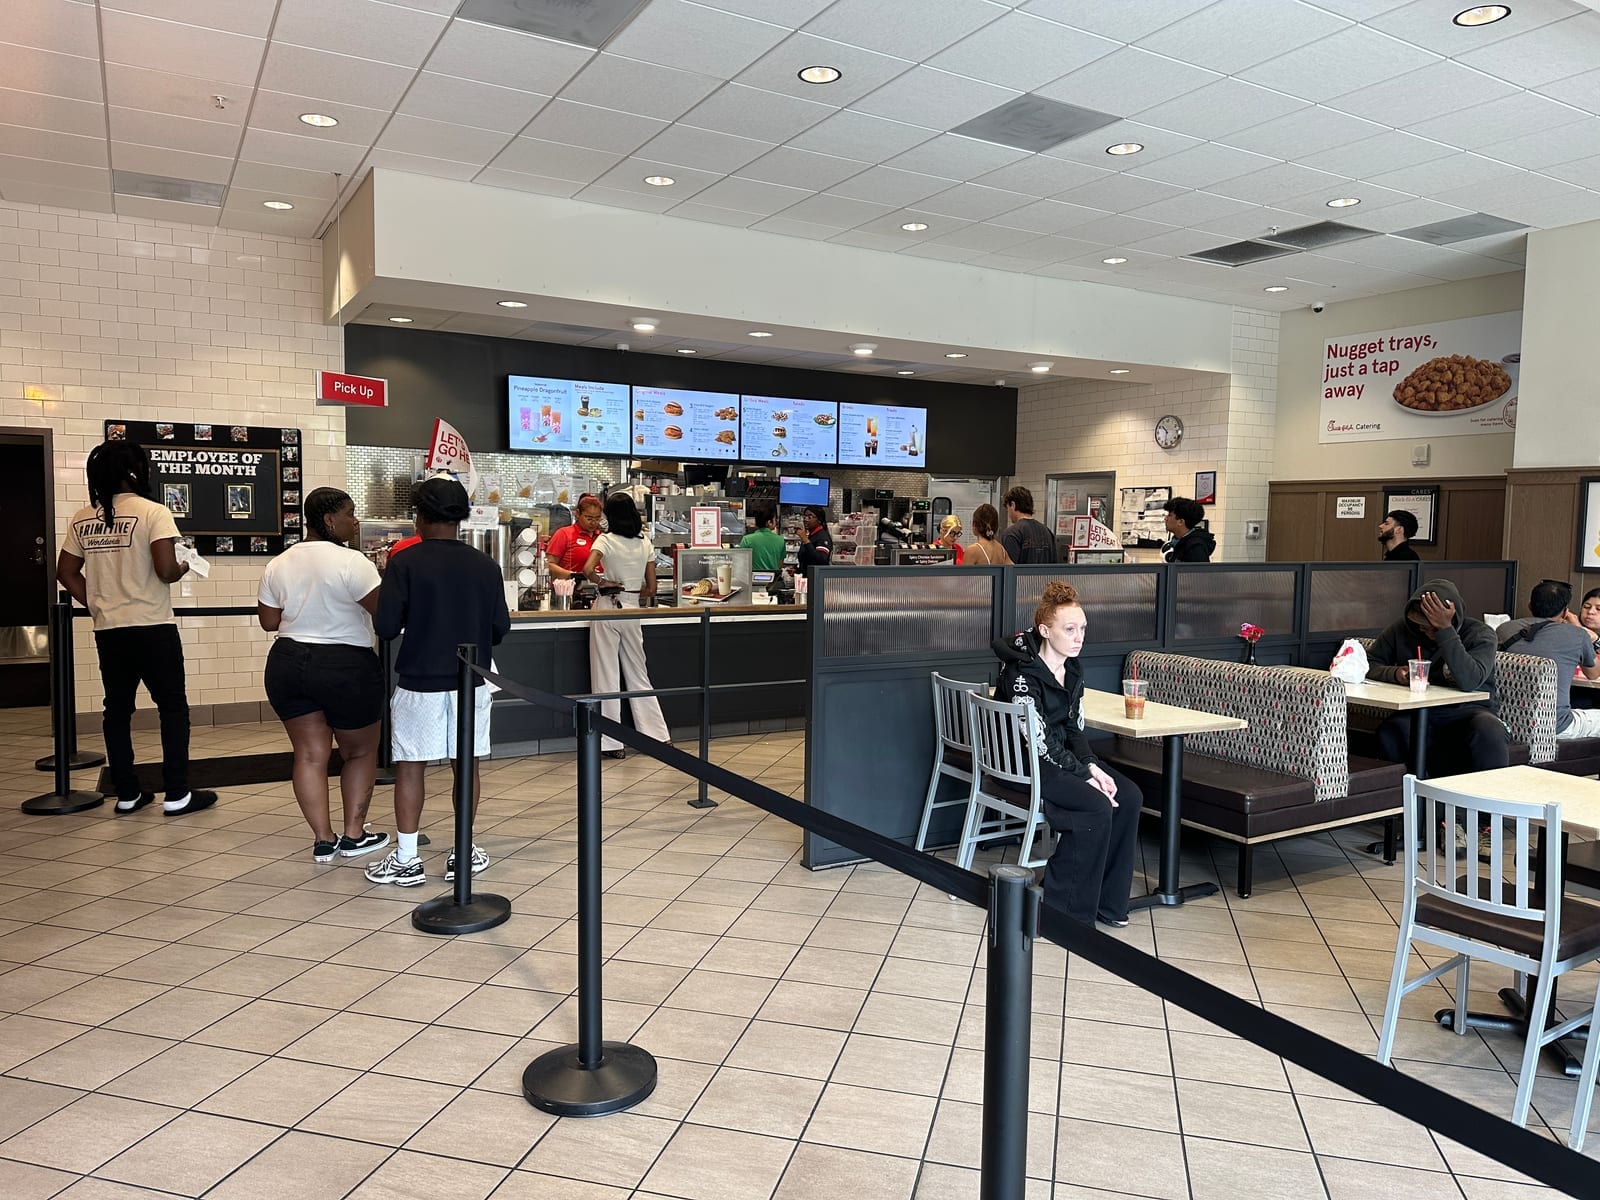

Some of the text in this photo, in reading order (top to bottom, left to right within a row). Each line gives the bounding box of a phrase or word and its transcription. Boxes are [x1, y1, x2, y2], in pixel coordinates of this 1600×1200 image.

[1327, 335, 1438, 360] Nugget trays,
[1324, 359, 1400, 383] just a tap
[334, 381, 374, 399] Pick Up
[513, 384, 538, 393] Pineapple
[539, 387, 568, 395] Dragonfruit
[1324, 384, 1365, 400] away
[1355, 423, 1381, 431] Catering
[150, 449, 263, 465] EMPLOYEE OF
[438, 443, 457, 458] GO
[157, 462, 257, 477] THE MONTH
[87, 538, 121, 547] Worldwide
